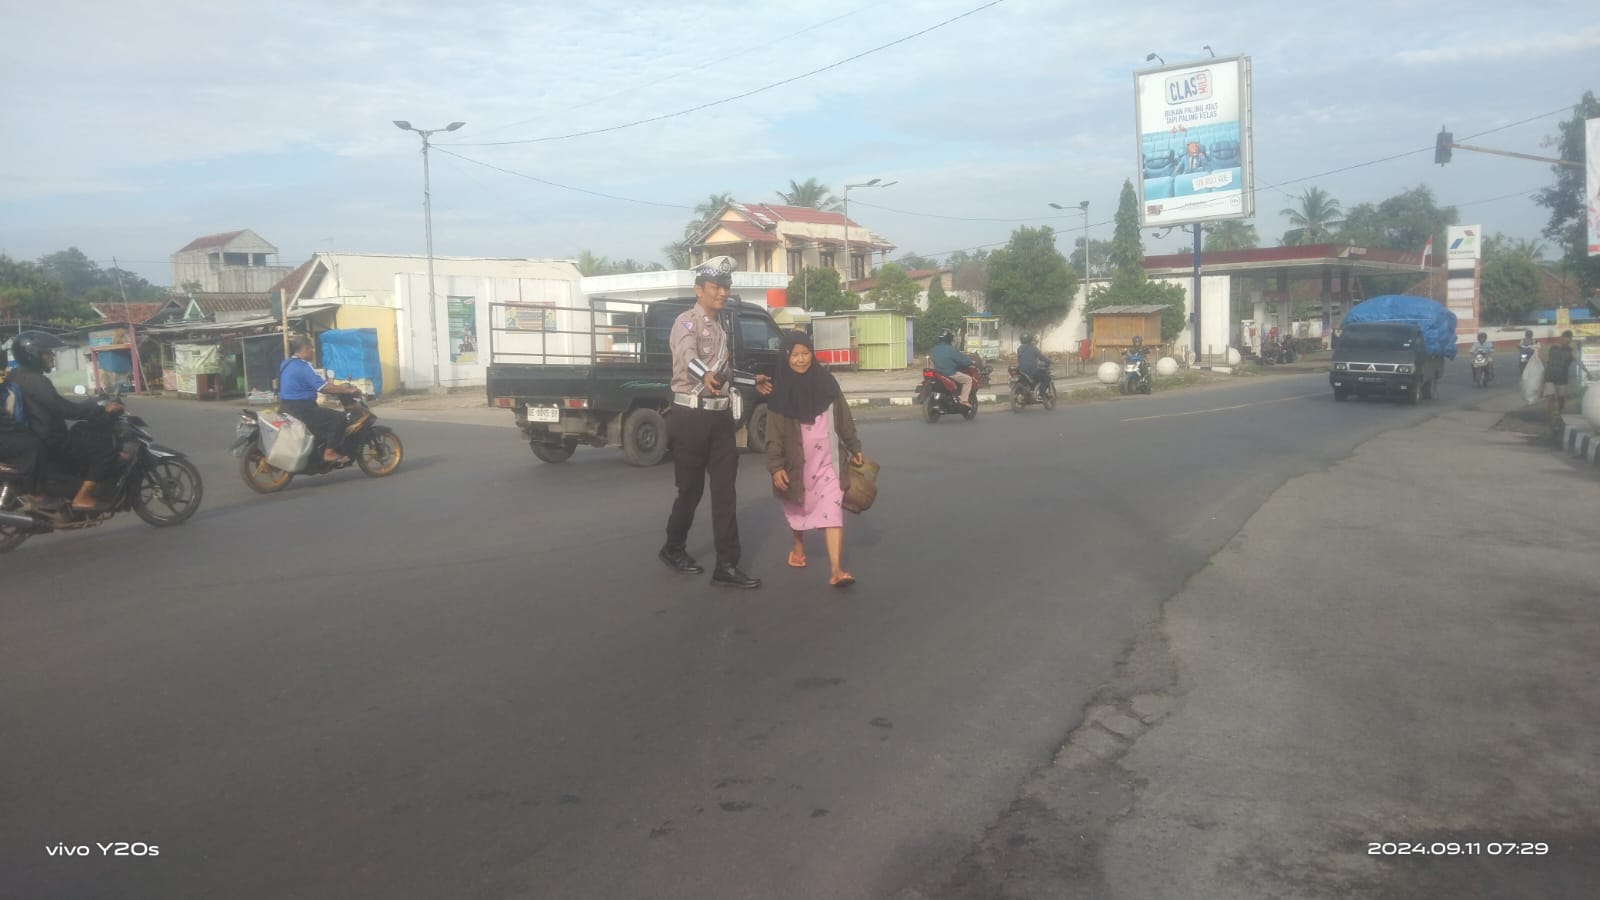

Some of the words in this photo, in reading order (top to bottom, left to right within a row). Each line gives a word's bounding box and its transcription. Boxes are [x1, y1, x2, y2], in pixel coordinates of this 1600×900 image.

[1169, 77, 1198, 102] CLAS
[1178, 113, 1199, 123] PALING
[1199, 110, 1217, 120] KELAS
